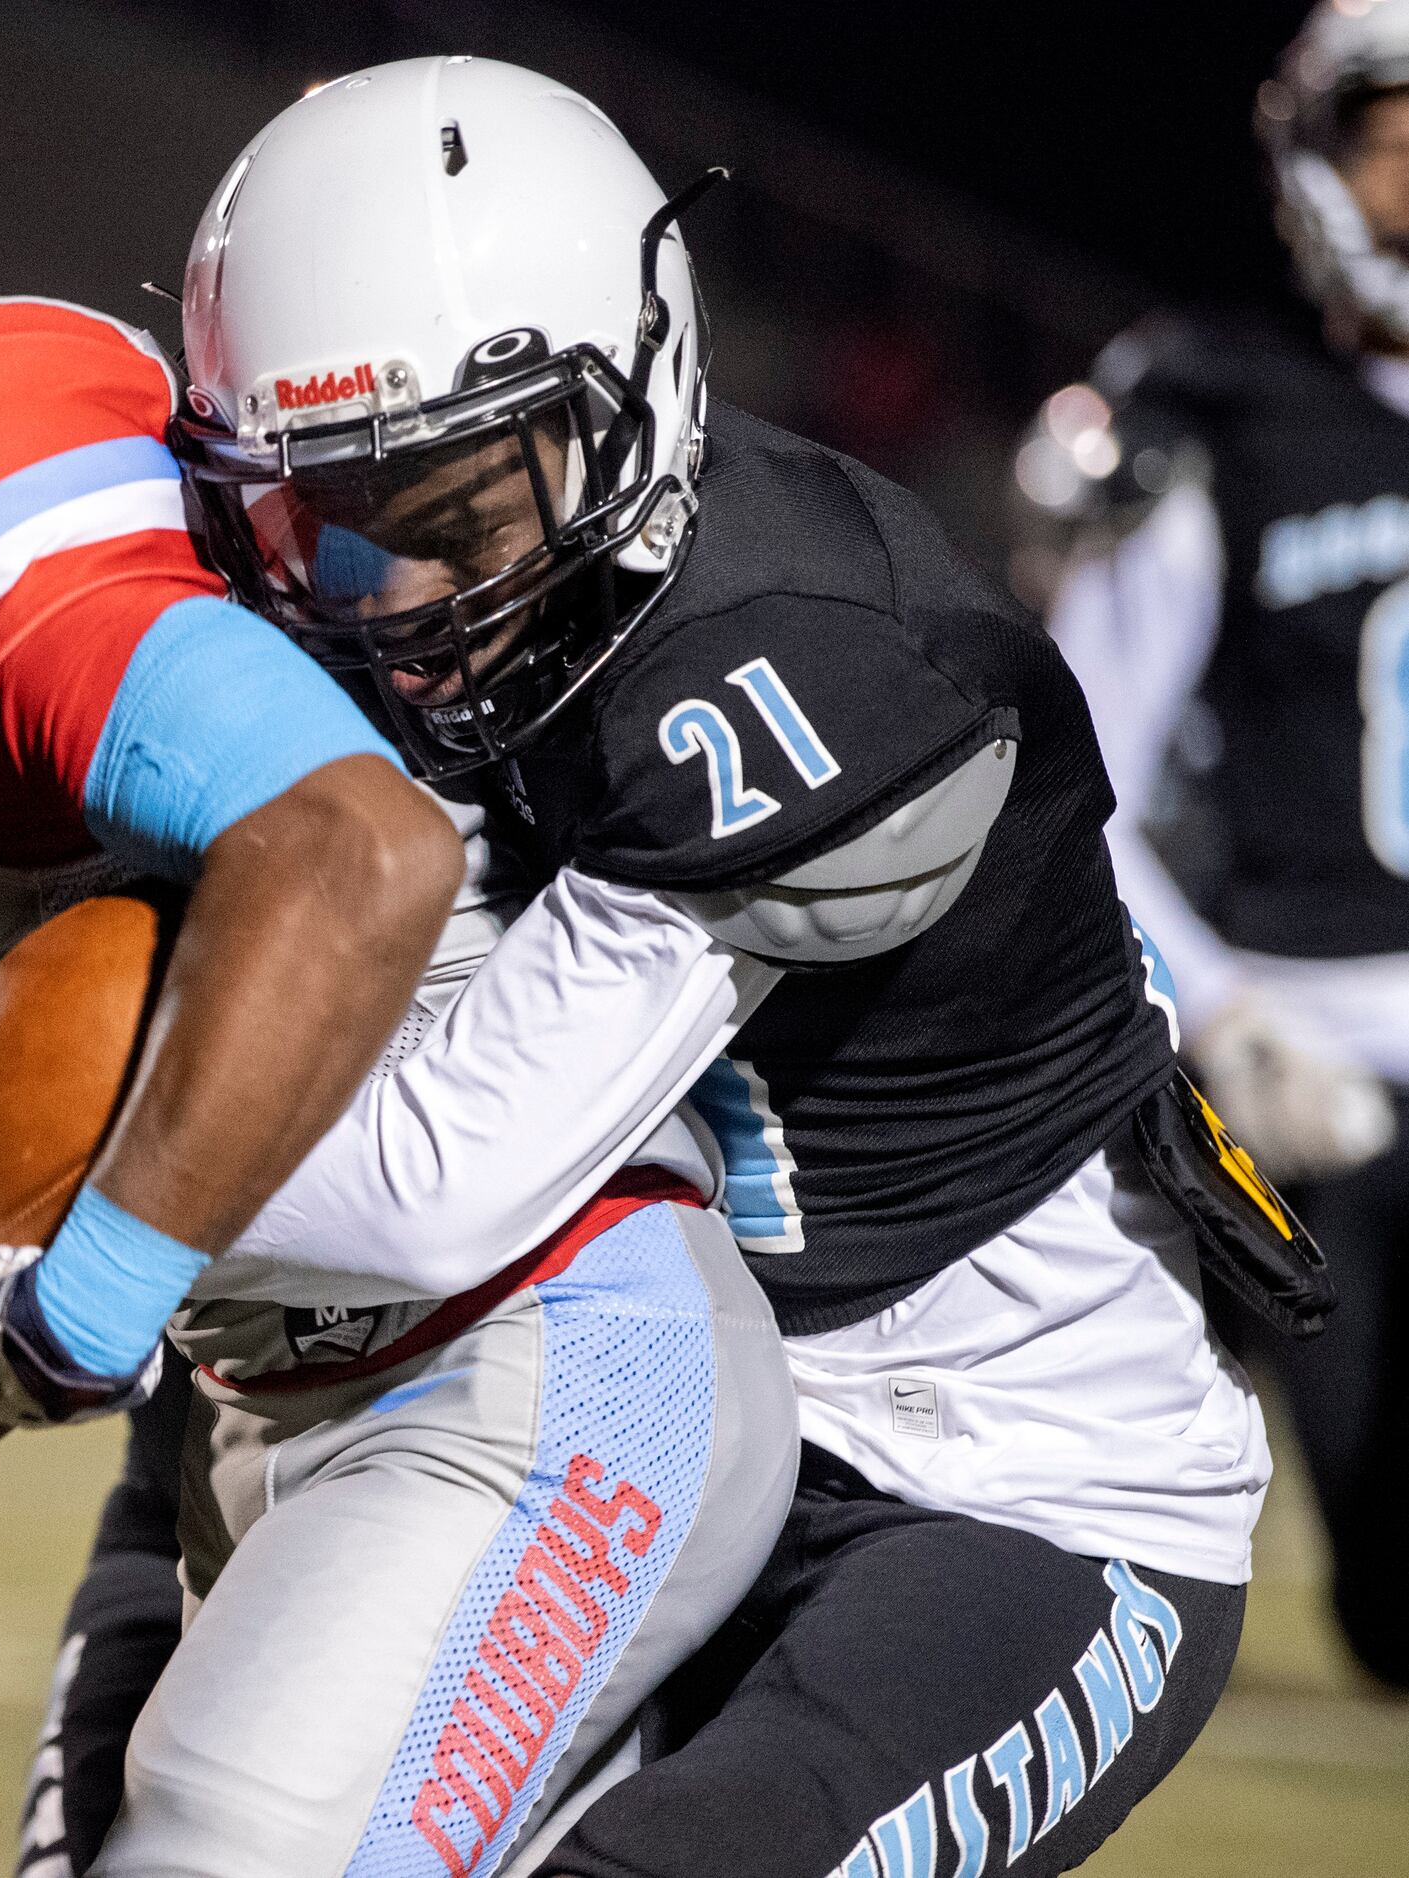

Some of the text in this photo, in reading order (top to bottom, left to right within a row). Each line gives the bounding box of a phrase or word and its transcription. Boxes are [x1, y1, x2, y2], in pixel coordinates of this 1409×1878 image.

[275, 362, 375, 410] Riddell
[431, 698, 496, 724] Riddll
[658, 656, 842, 840] 21
[895, 1404, 935, 1416] NIKE PRO
[411, 1453, 663, 1878] COWBOYS
